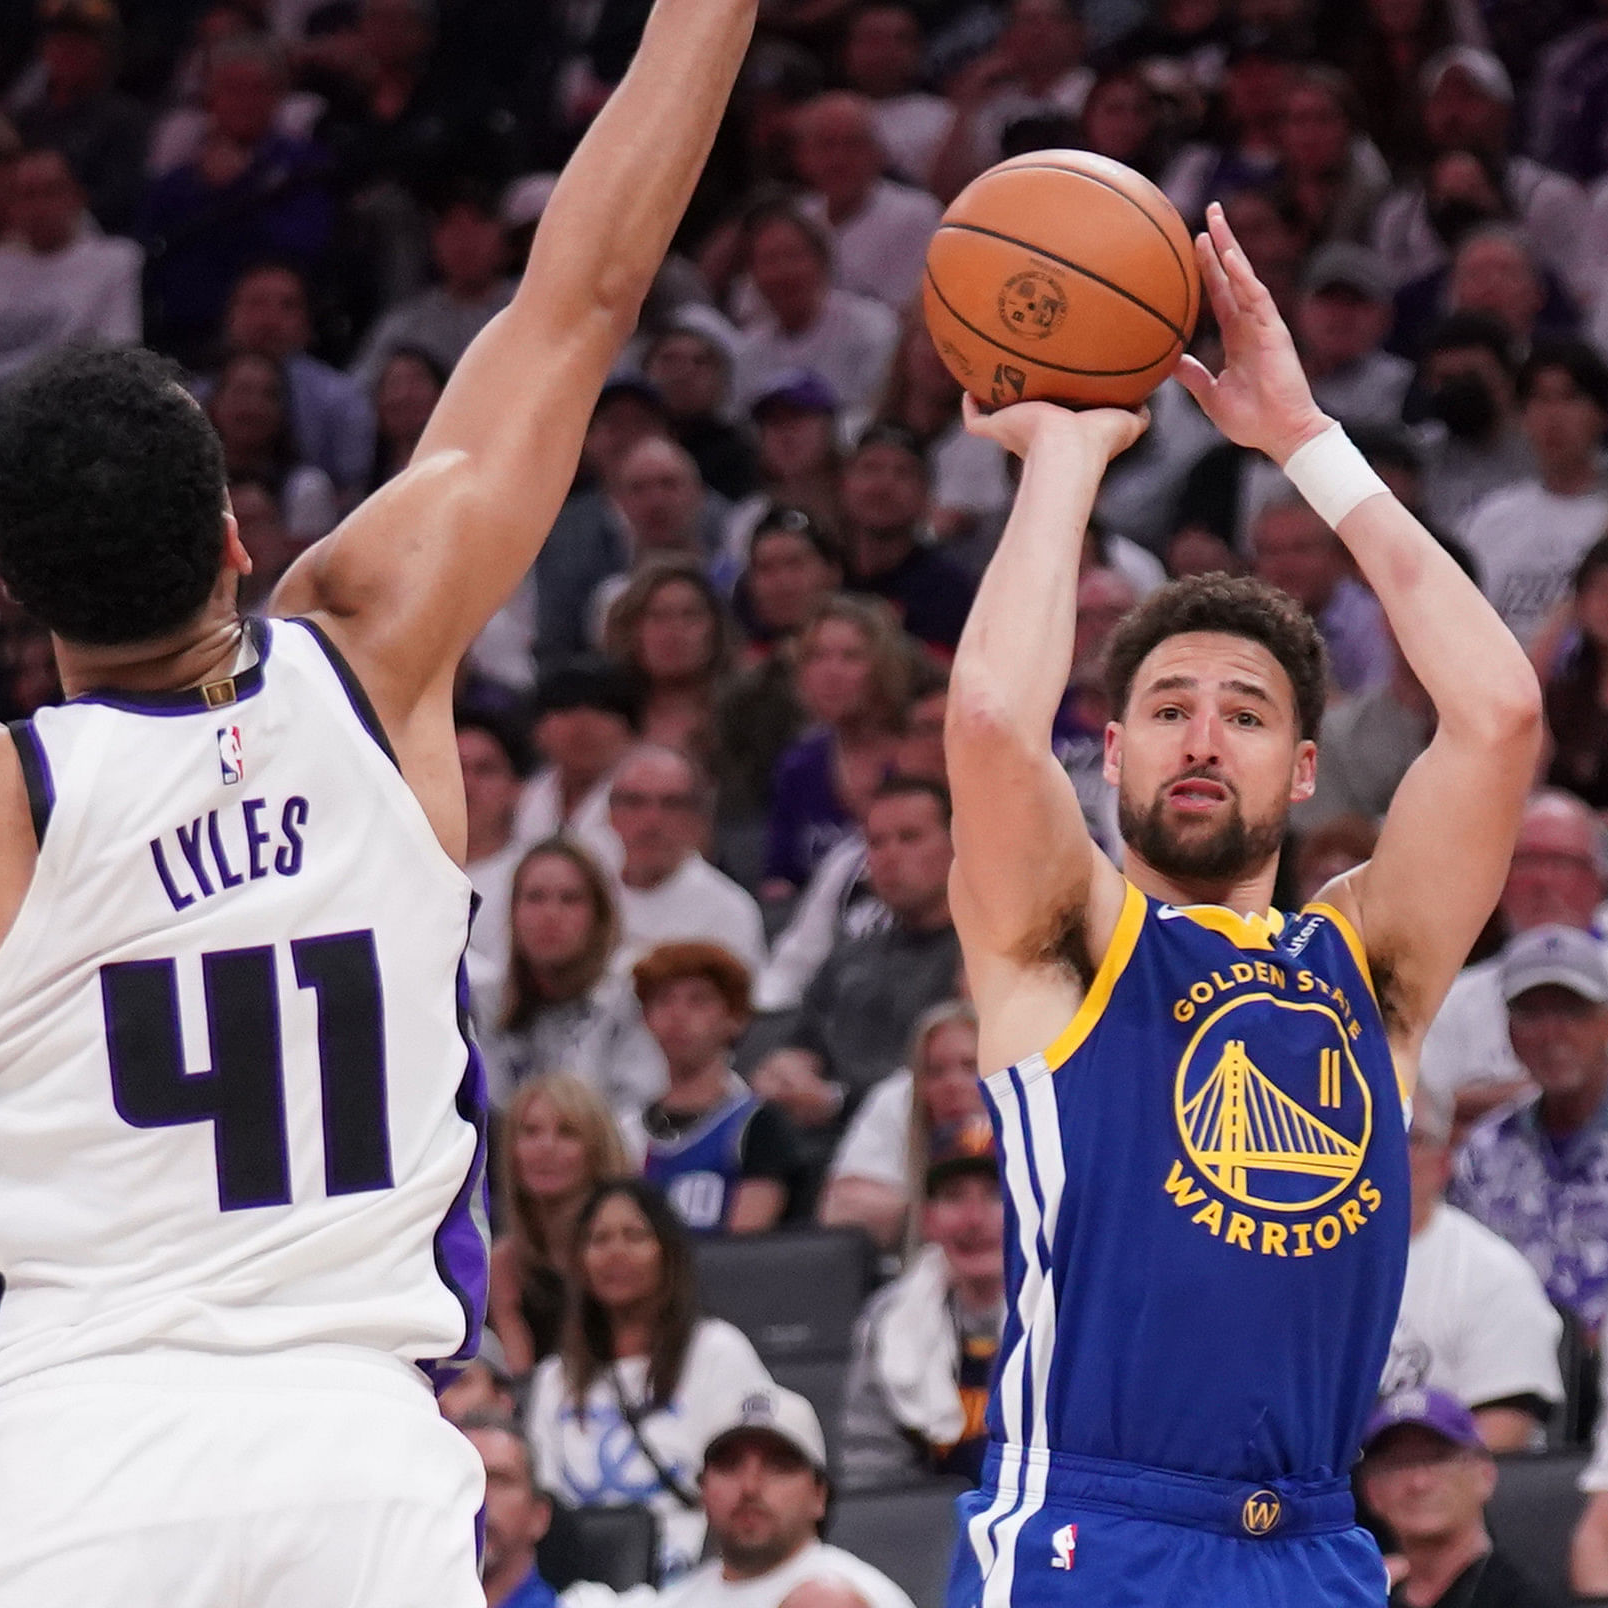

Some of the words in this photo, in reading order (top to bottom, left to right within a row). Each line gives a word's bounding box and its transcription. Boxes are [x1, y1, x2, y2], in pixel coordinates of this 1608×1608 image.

[150, 796, 310, 912] LYLES
[1286, 917, 1326, 955] uten
[1173, 961, 1286, 1023] GOLDEN
[1297, 970, 1363, 1041] STATE
[99, 928, 395, 1213] 41
[1319, 1047, 1341, 1109] 11
[1163, 1158, 1382, 1258] WARRIORS
[1246, 1499, 1280, 1530] W
